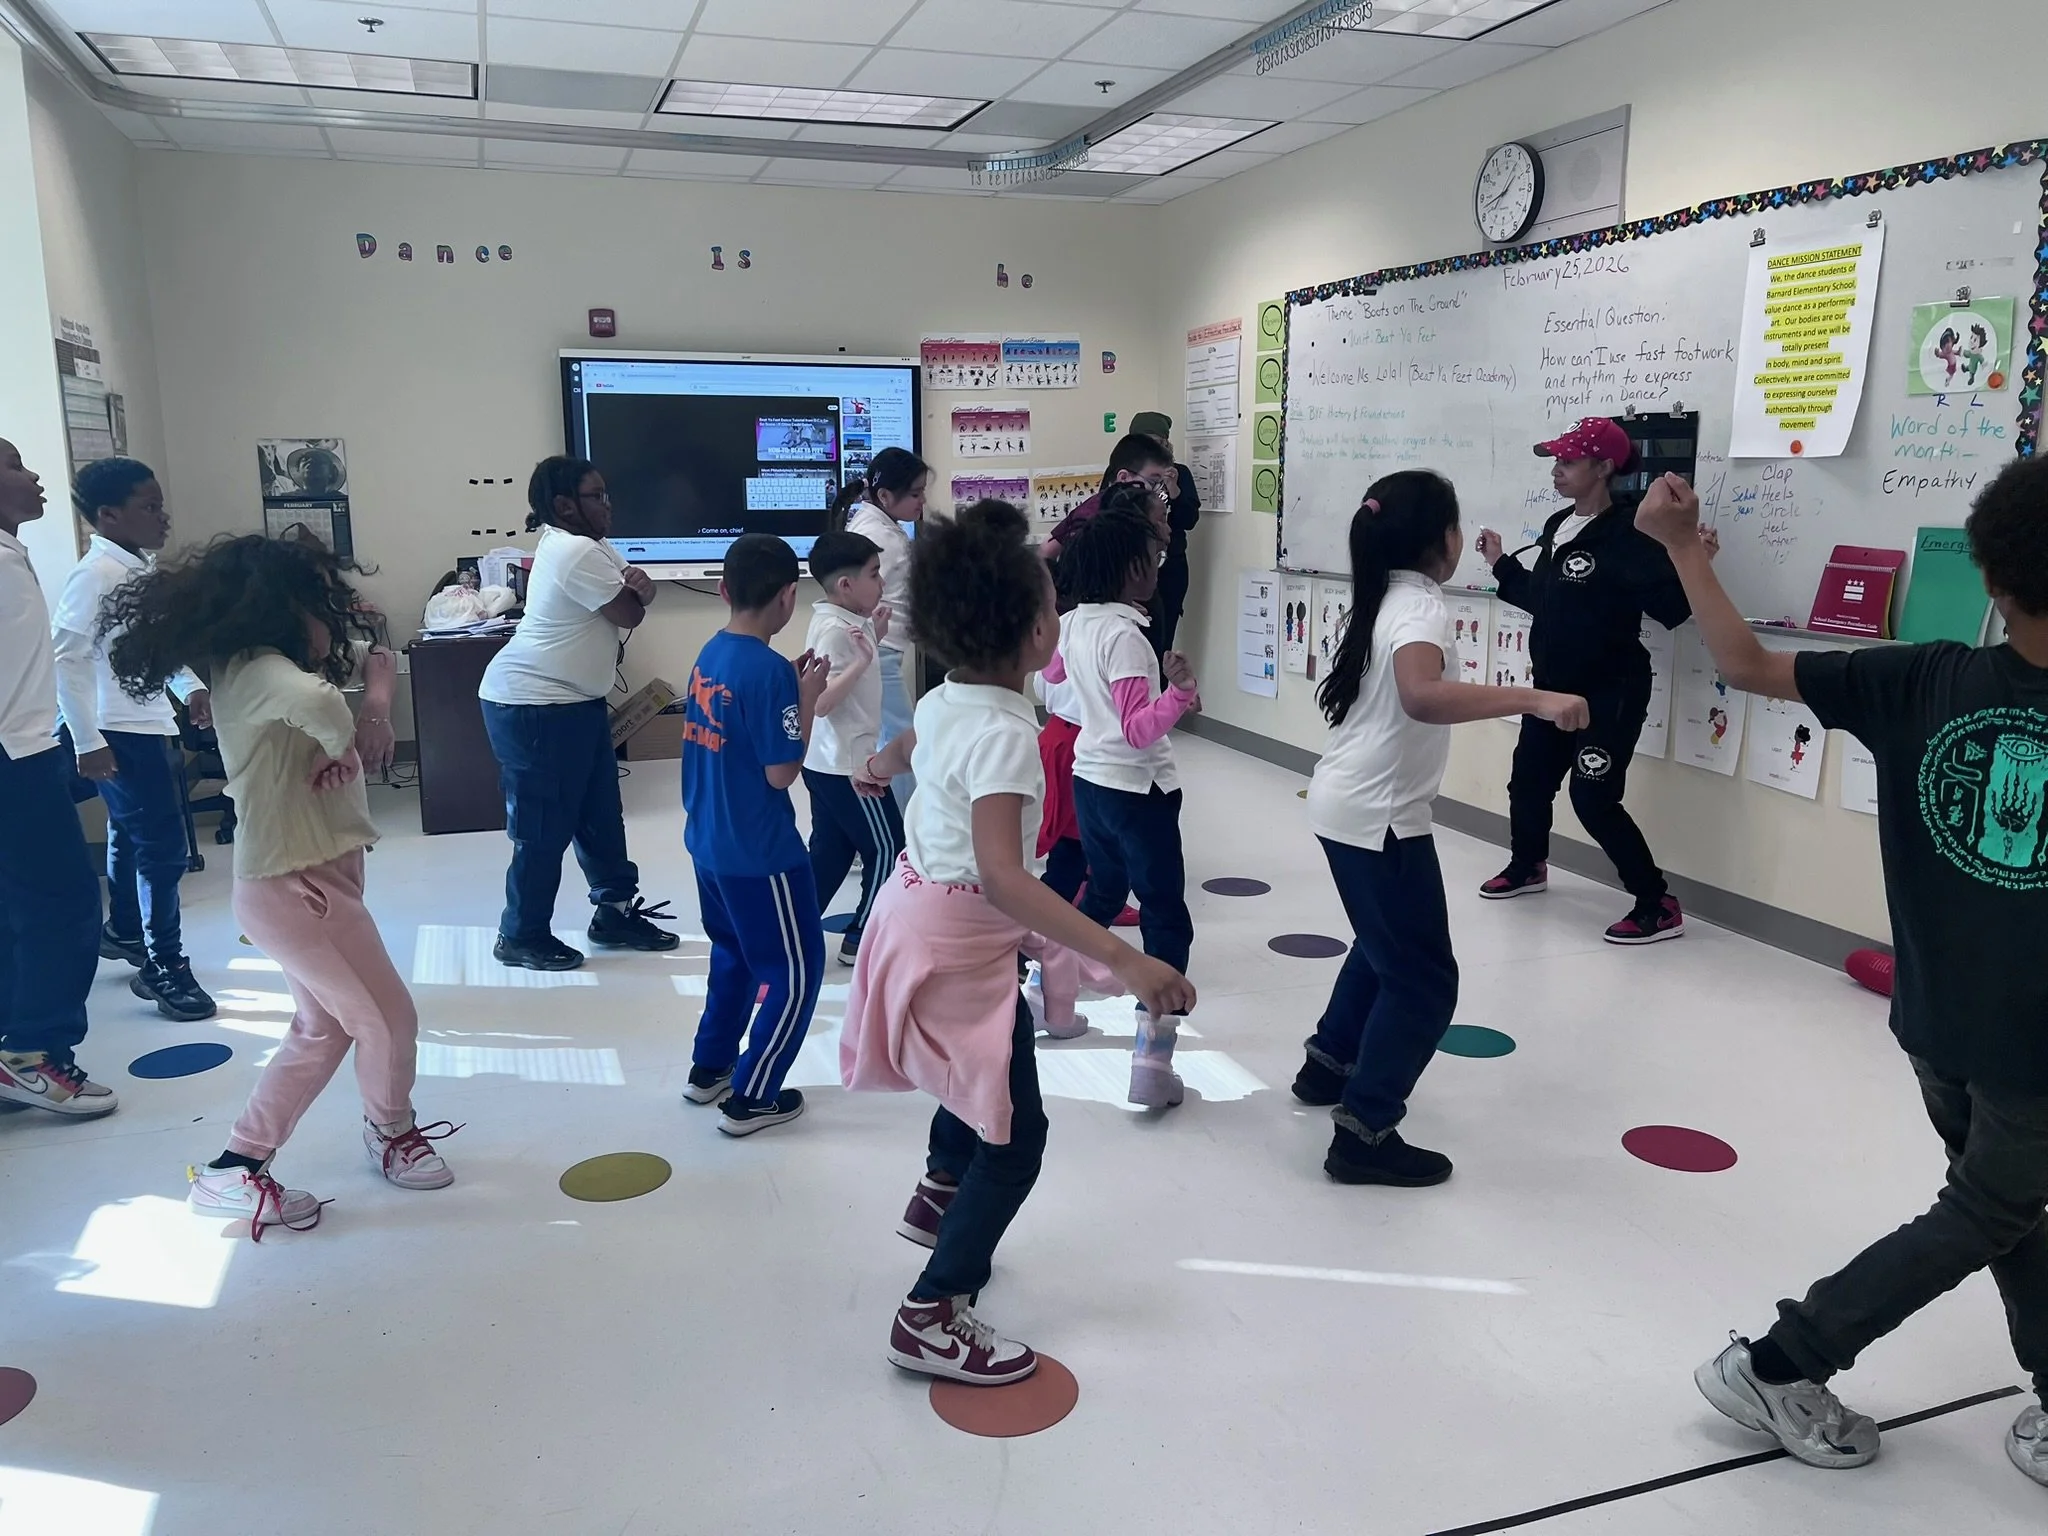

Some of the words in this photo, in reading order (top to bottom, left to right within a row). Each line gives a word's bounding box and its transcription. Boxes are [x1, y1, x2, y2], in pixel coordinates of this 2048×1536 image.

[1504, 148, 1512, 158] 12
[1518, 152, 1522, 160] 1
[1492, 158, 1499, 168] 11
[1526, 164, 1531, 174] 2
[1482, 175, 1490, 184] 10
[1527, 182, 1532, 192] 3
[1480, 194, 1485, 204] 9
[1522, 204, 1528, 214] 4
[1482, 212, 1487, 222] 8
[1489, 226, 1494, 236] 7
[1512, 221, 1518, 231] 5
[1500, 228, 1506, 238] 6
[356, 232, 513, 264] Dance
[1767, 257, 1790, 269] DANCE
[1791, 252, 1820, 265] MISSION
[1821, 245, 1863, 260] STATEMENT
[1784, 272, 1795, 281] the
[1796, 270, 1817, 280] dance
[1817, 266, 1847, 277] students
[1848, 263, 1856, 272] of
[1766, 288, 1792, 299] Barnard
[1793, 284, 1831, 297] Elementary
[1393, 304, 1404, 316] on
[1408, 298, 1425, 314] The
[1764, 305, 1781, 315] value
[1782, 302, 1802, 312] dance
[1817, 297, 1856, 310] performing
[1544, 307, 1600, 334] Essential
[1784, 317, 1797, 326] Our
[1798, 314, 1821, 325] bodies
[1834, 312, 1847, 320] our
[1763, 329, 1802, 341] instruments
[1802, 328, 1816, 337] and
[1829, 326, 1841, 334] will
[1842, 324, 1851, 334] be
[1782, 344, 1803, 353] totally
[1803, 340, 1829, 351] present
[1540, 347, 1567, 370] How
[1595, 346, 1608, 366] I
[1609, 352, 1626, 363] use
[1636, 340, 1665, 362] fast
[1674, 337, 1734, 363] footwork
[1102, 351, 1117, 374] B
[1766, 360, 1772, 368] in
[1792, 356, 1808, 366] mind
[1810, 356, 1823, 365] and
[1545, 371, 1566, 389] and
[1572, 370, 1615, 391] rhythm
[1623, 368, 1637, 383] to
[1645, 370, 1692, 388] express
[1815, 370, 1851, 381] committed
[1546, 389, 1592, 414] myself
[1600, 393, 1613, 404] in
[1620, 386, 1669, 402] Dance?
[1764, 391, 1771, 399] to
[1772, 390, 1806, 400] expressing
[1807, 388, 1837, 397] ourselves
[1932, 393, 1950, 408] R
[1970, 393, 1984, 407] L
[1765, 404, 1807, 415] authentically
[1807, 403, 1833, 414] through
[1104, 412, 1117, 433] E
[1891, 412, 1941, 440] Word
[1947, 409, 1974, 438] of
[1976, 416, 2007, 439] the
[1762, 463, 1793, 485] Clap
[1882, 468, 1978, 498] Empathy
[1458, 605, 1472, 614] LEVEL
